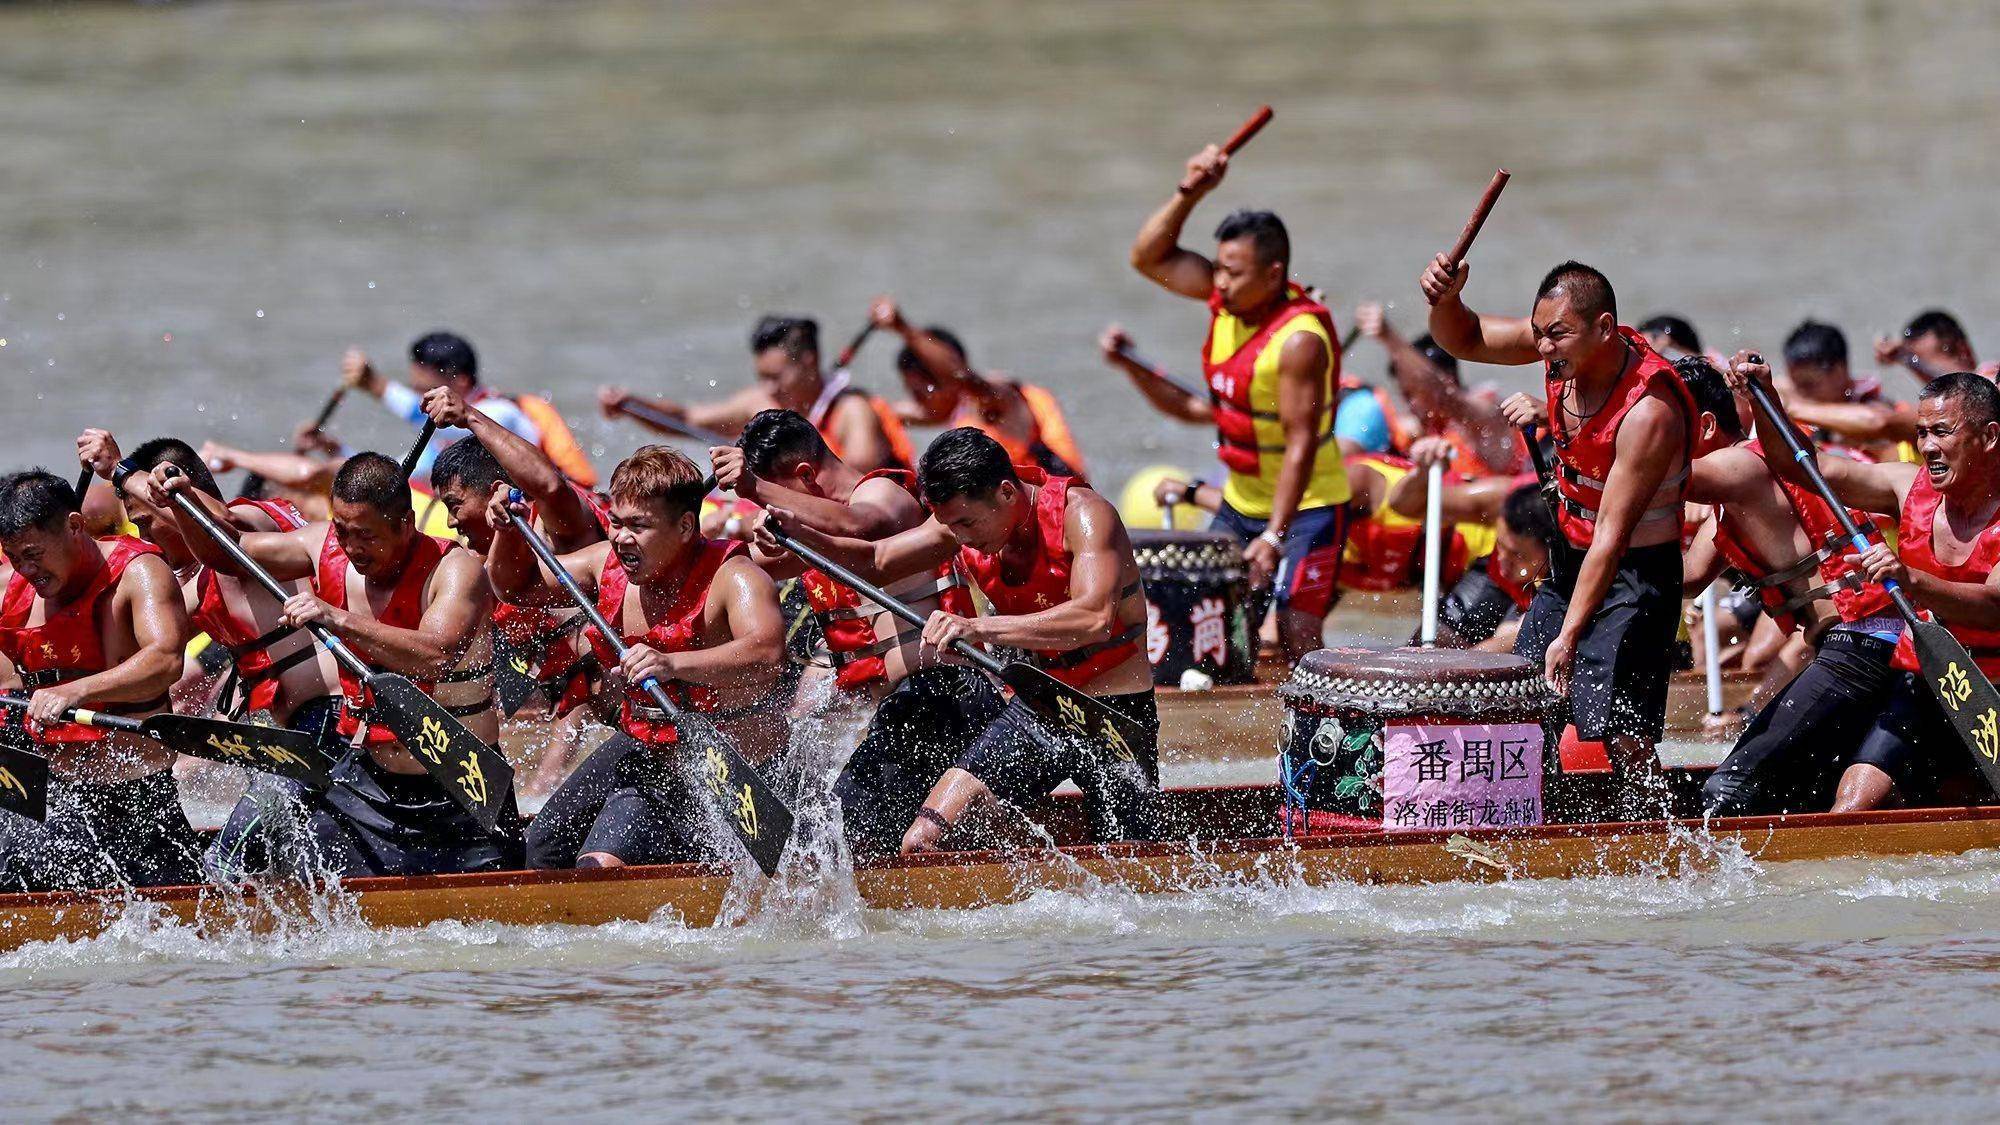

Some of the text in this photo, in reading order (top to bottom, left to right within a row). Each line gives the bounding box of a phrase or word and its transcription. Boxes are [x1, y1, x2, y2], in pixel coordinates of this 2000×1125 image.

[1410, 738, 1529, 783] 番禺区
[1394, 797, 1537, 828] 洛浦街龙舟队
